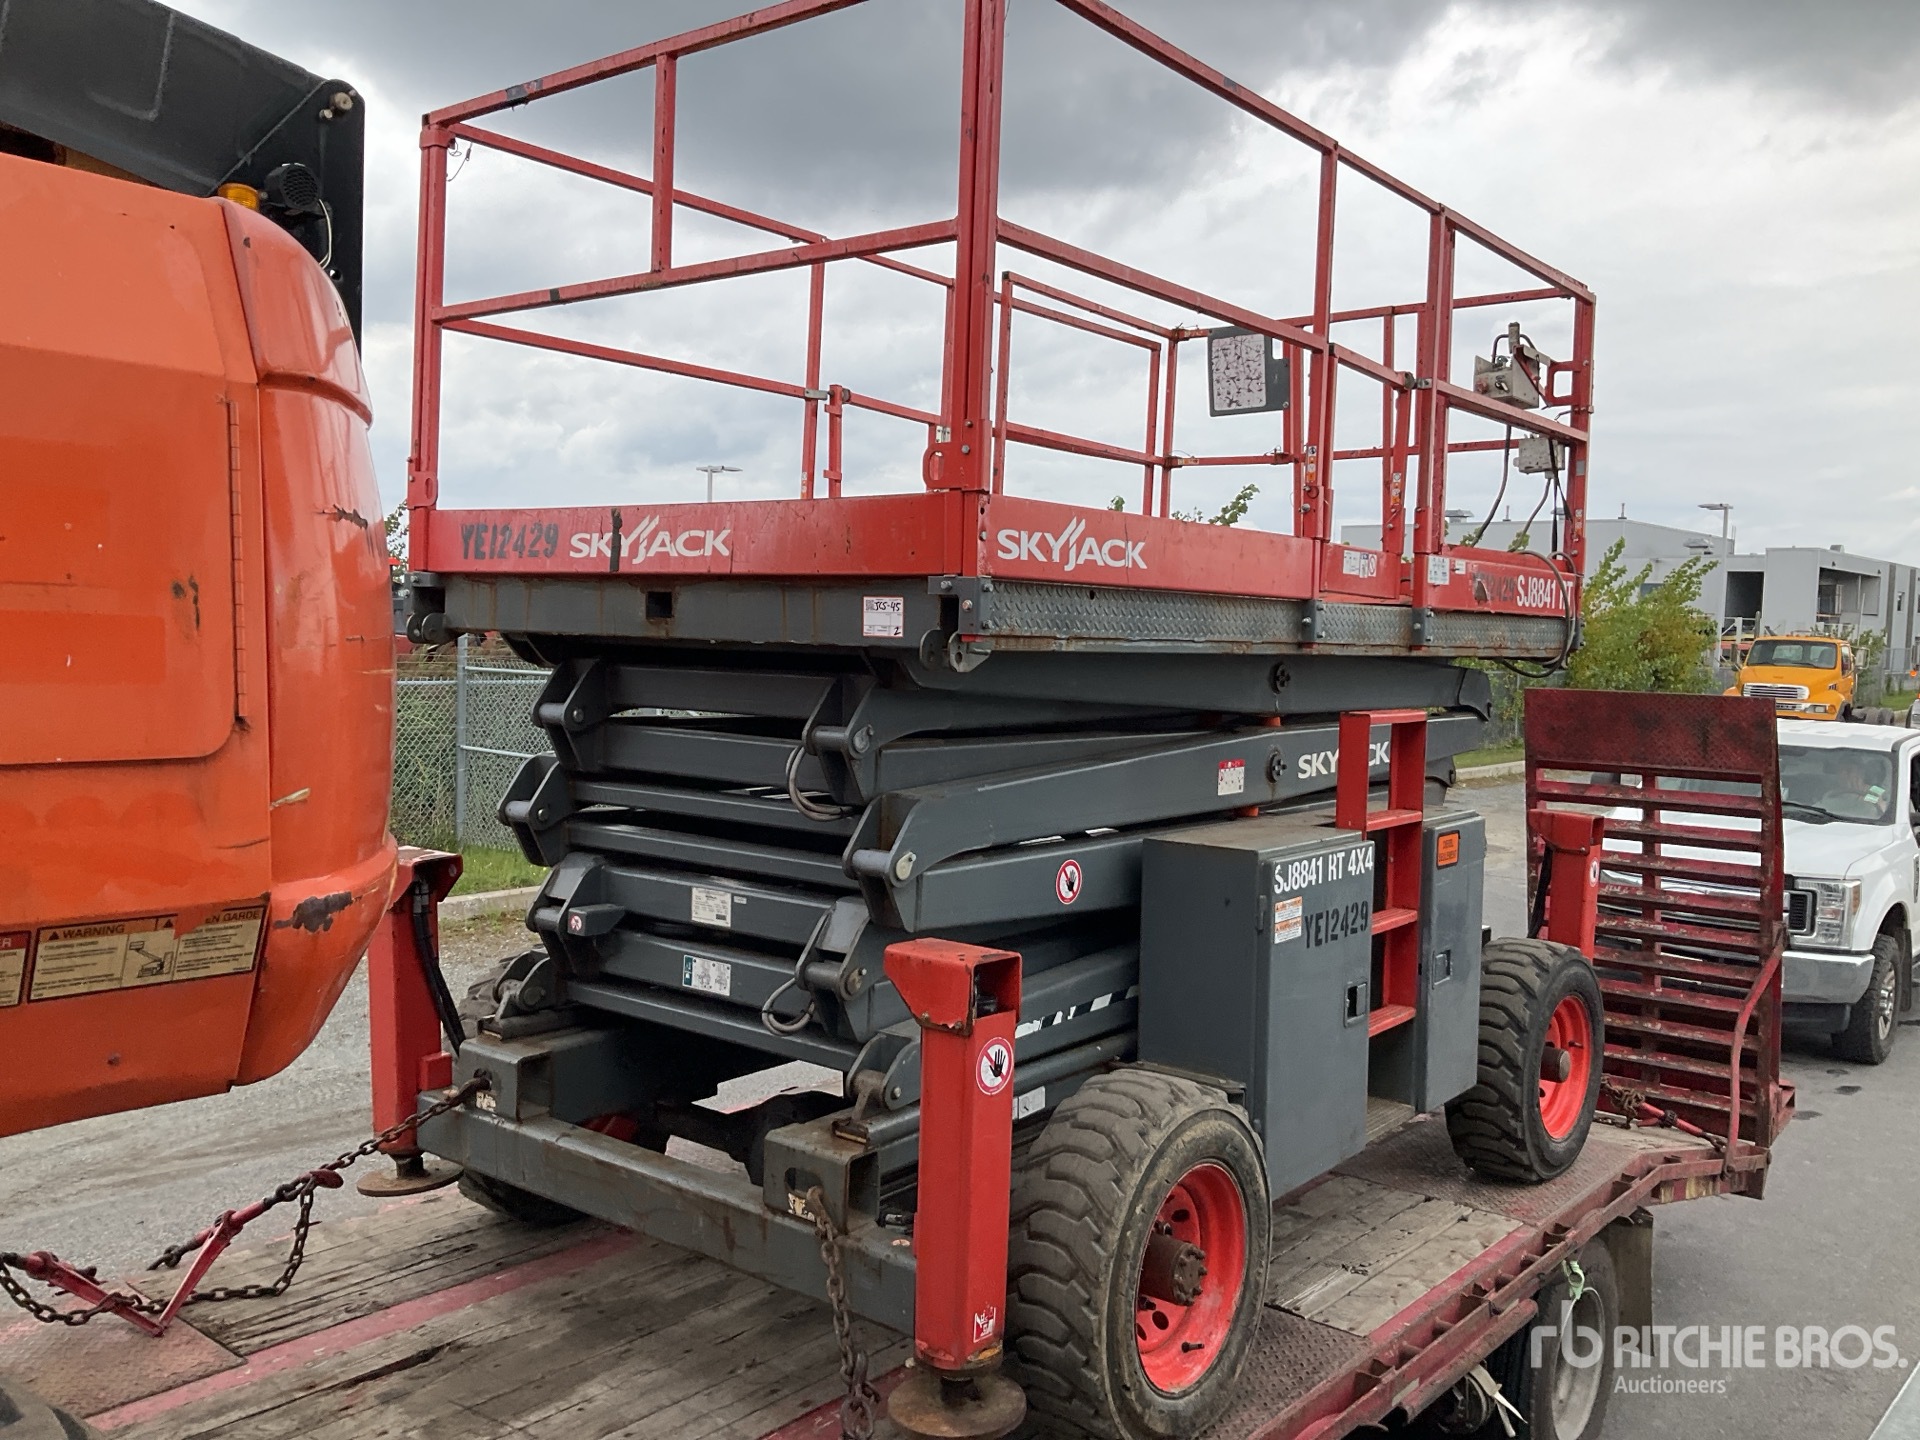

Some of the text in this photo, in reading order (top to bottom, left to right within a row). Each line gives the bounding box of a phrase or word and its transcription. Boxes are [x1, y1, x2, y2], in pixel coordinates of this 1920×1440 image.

[461, 522, 560, 560] YE12429
[569, 514, 731, 566] SKYJACK
[997, 516, 1148, 572] SKYJACK
[1516, 574, 1556, 610] SJ8841
[1298, 740, 1391, 780] SKYCK
[1274, 845, 1374, 894] SJ8841 RT 4X4
[62, 923, 125, 939] WARNING
[1304, 900, 1369, 950] YE12429
